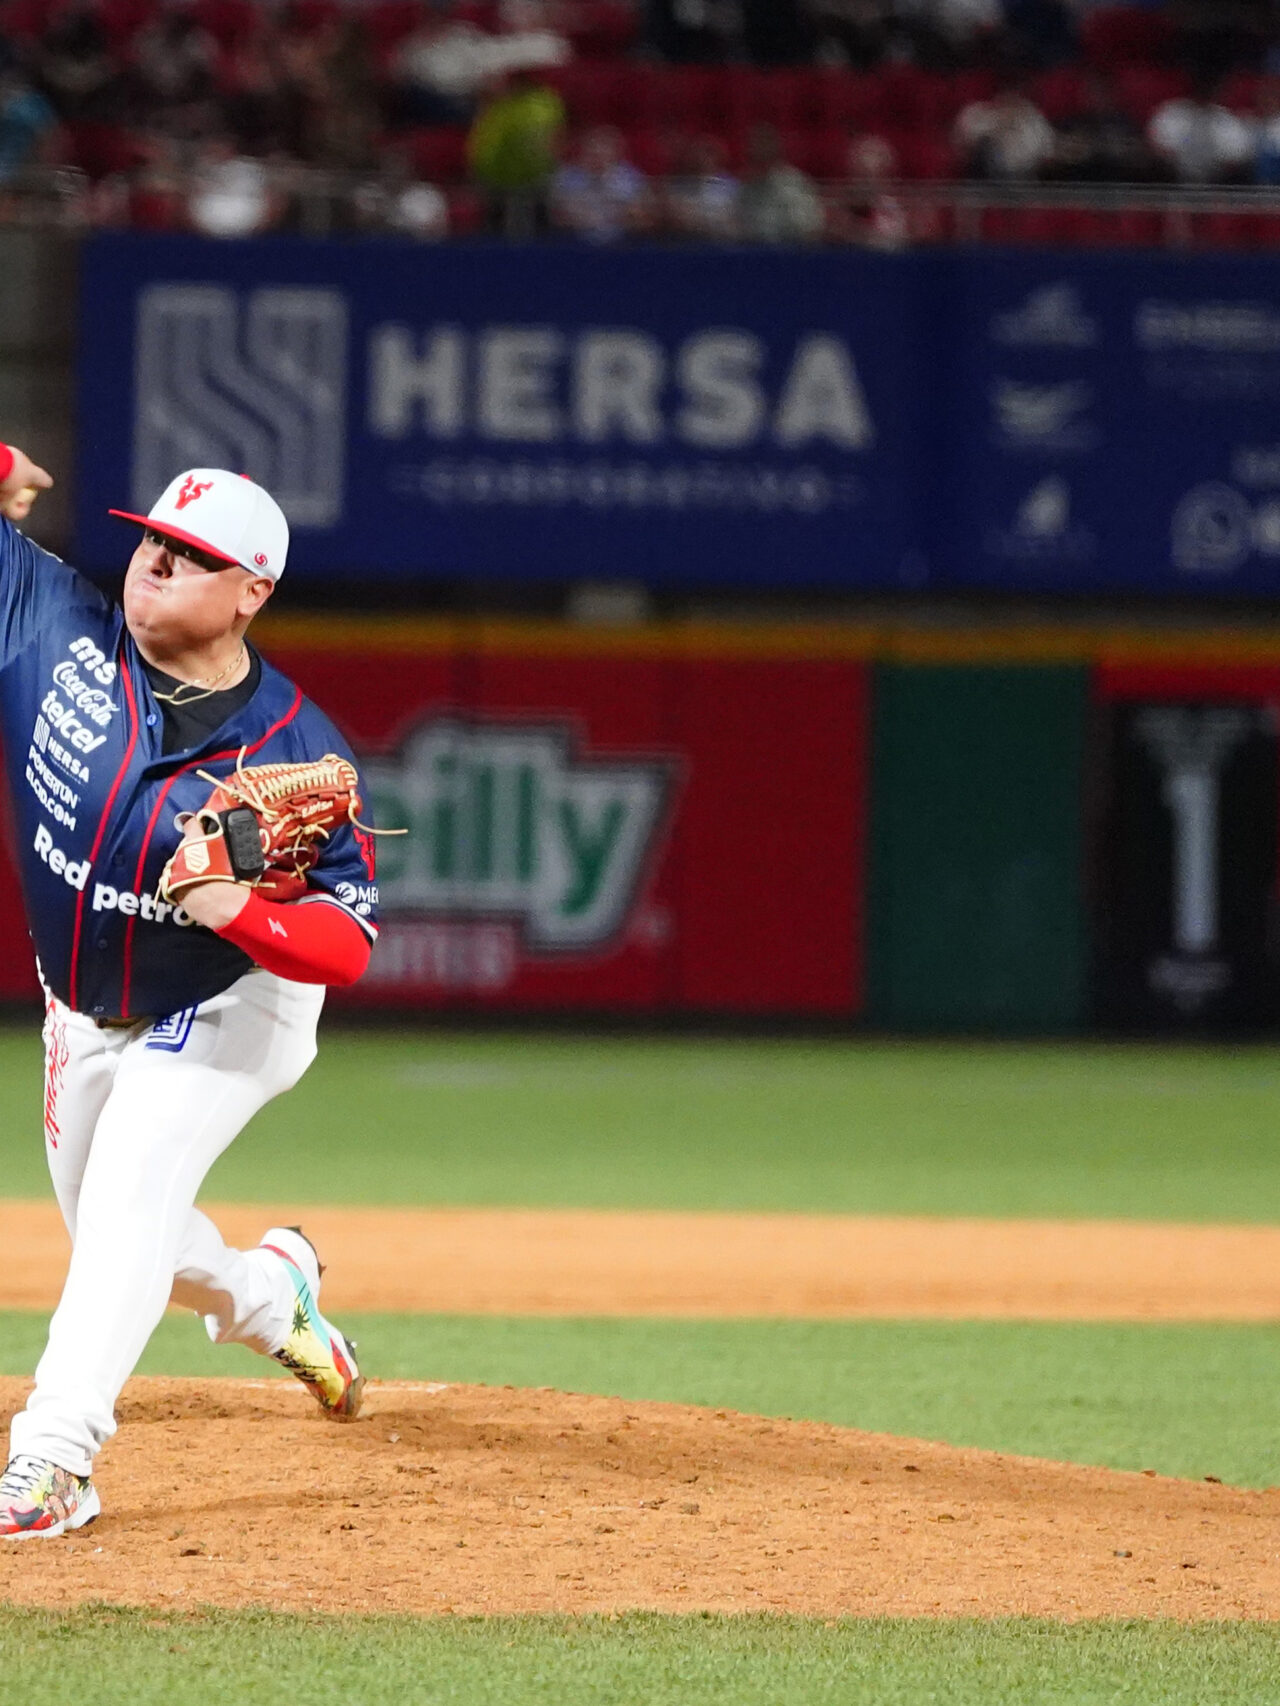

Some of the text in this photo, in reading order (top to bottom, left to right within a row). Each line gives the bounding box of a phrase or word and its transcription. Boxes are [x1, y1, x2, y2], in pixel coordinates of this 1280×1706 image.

[369, 326, 874, 448] HERSA
[41, 690, 107, 754] telcel
[47, 736, 90, 783] HERSA
[34, 823, 205, 928] Red petro
